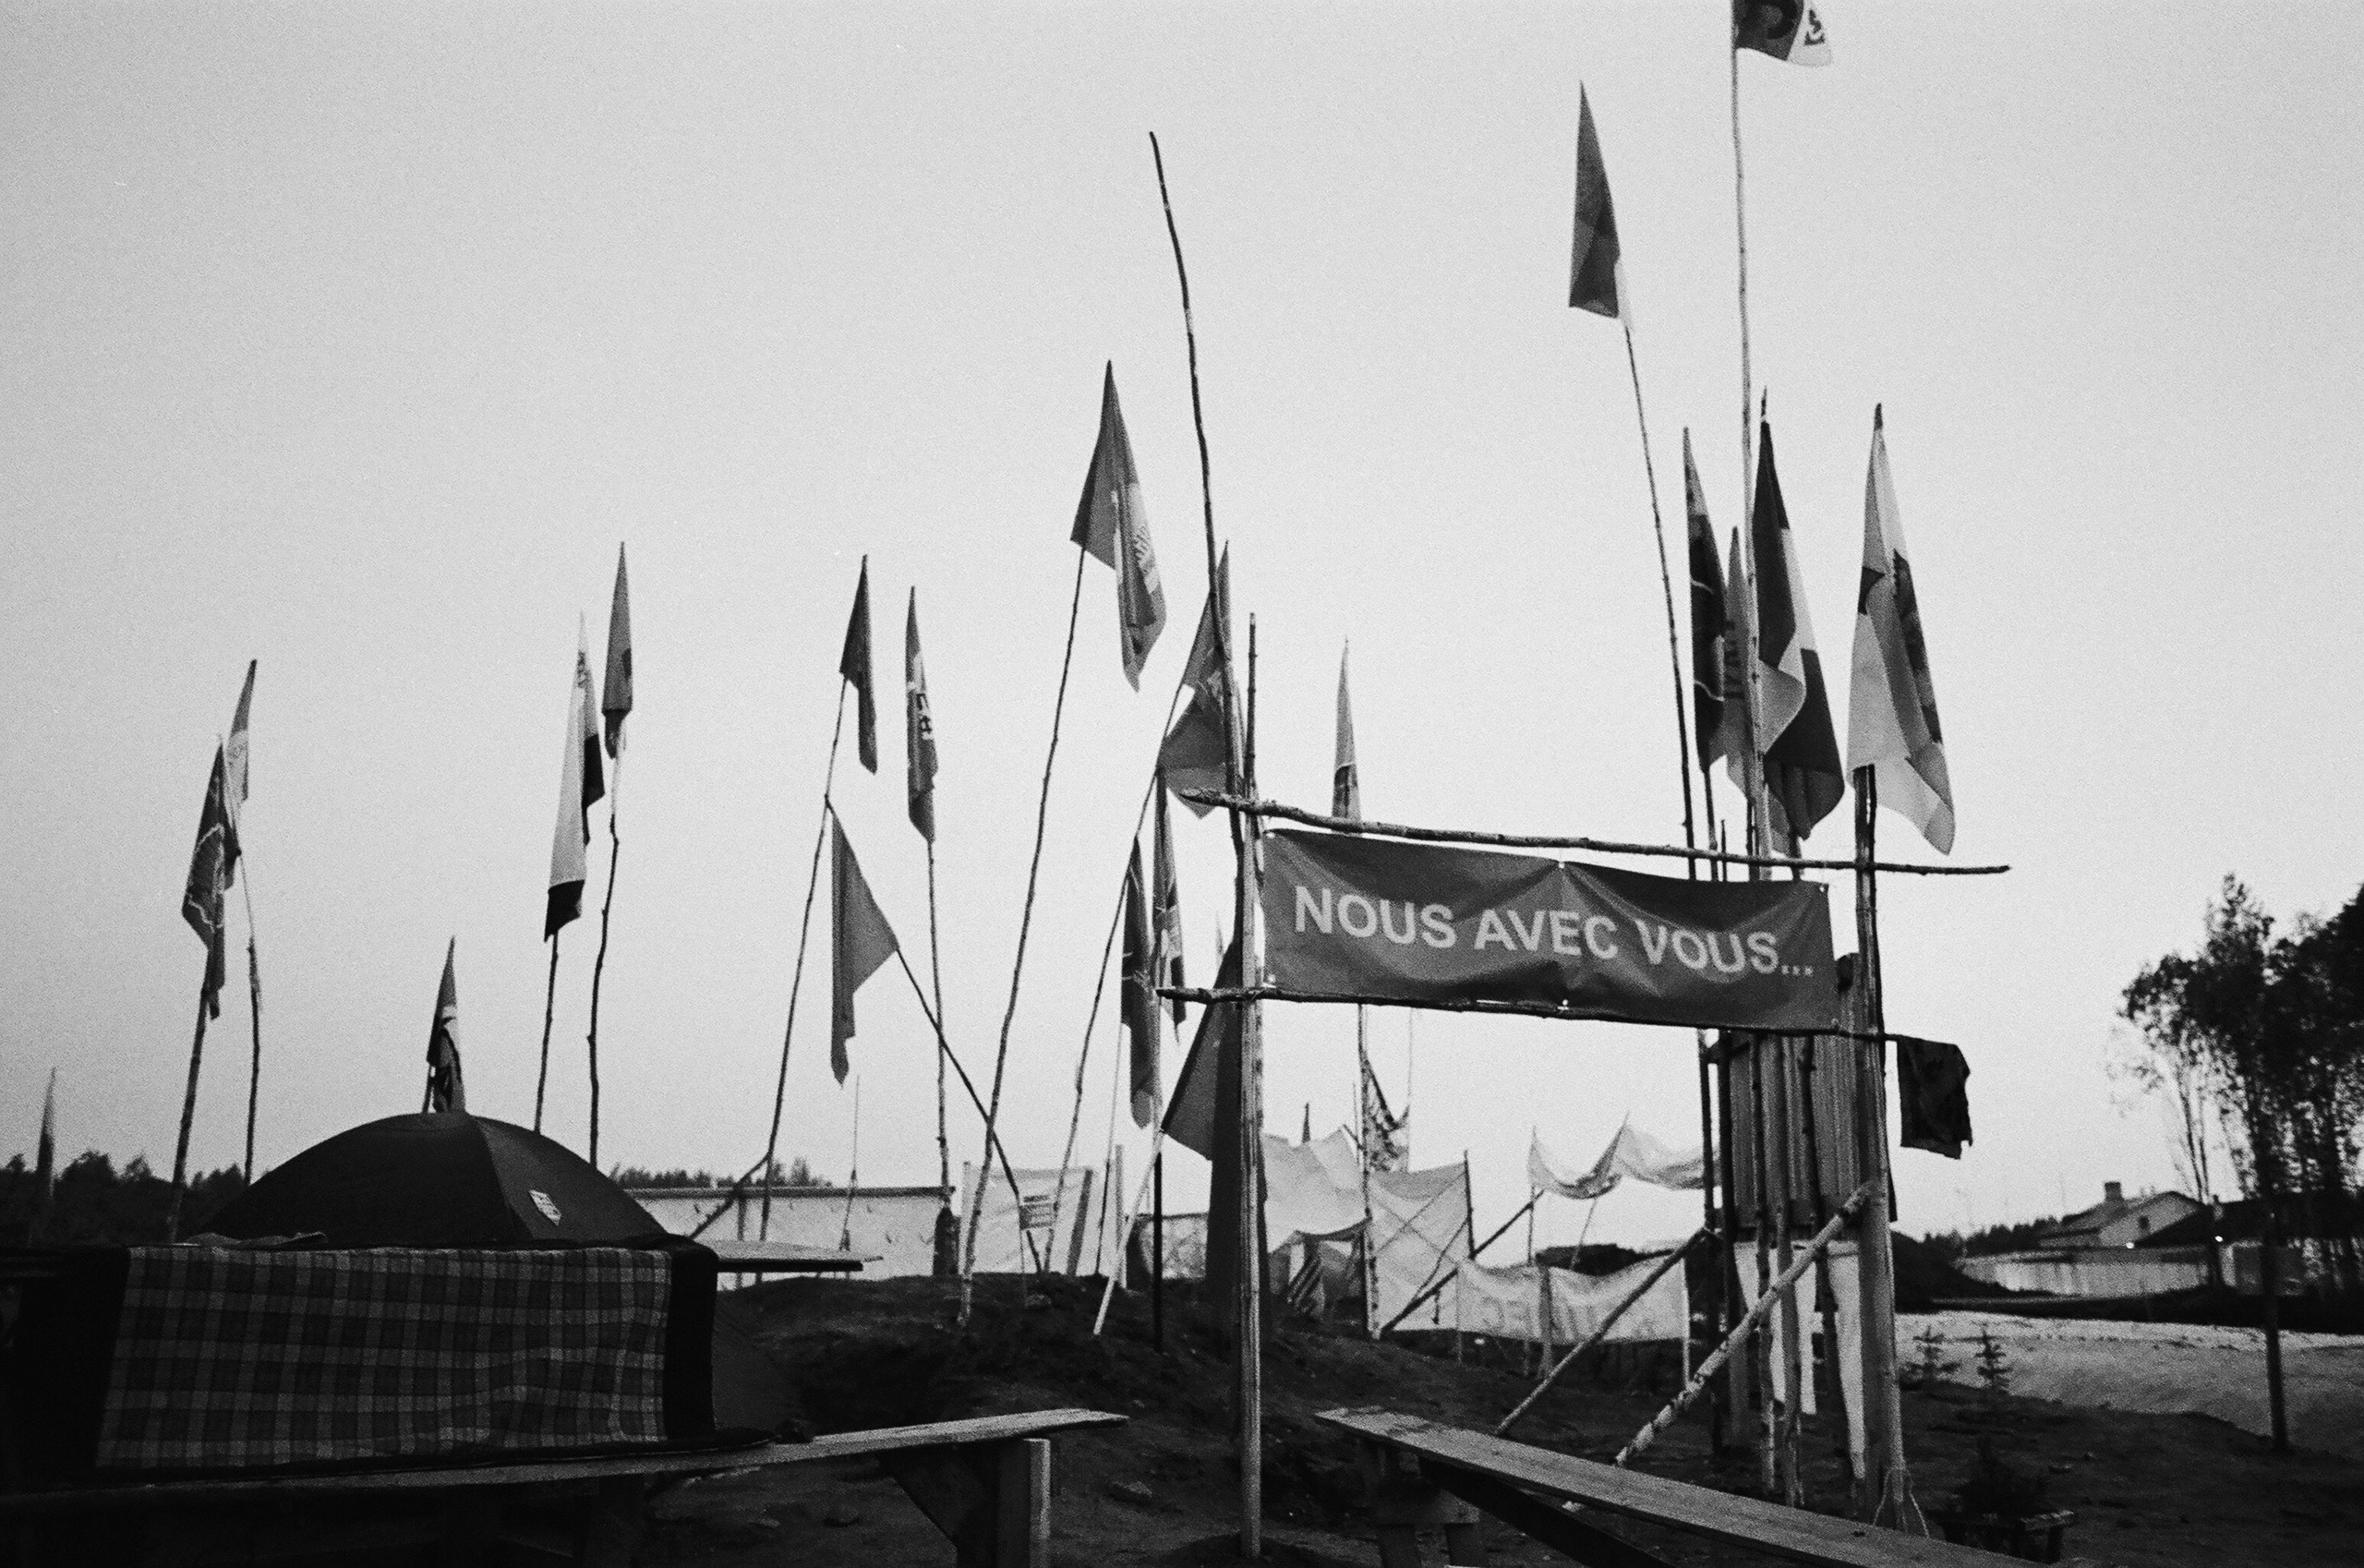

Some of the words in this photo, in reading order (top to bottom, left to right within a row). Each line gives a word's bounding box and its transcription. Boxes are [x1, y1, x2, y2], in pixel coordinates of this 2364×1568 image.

[1295, 885, 1457, 949] NOUS
[1474, 908, 1618, 960] AVEC
[1634, 918, 1814, 975] VOUS...
